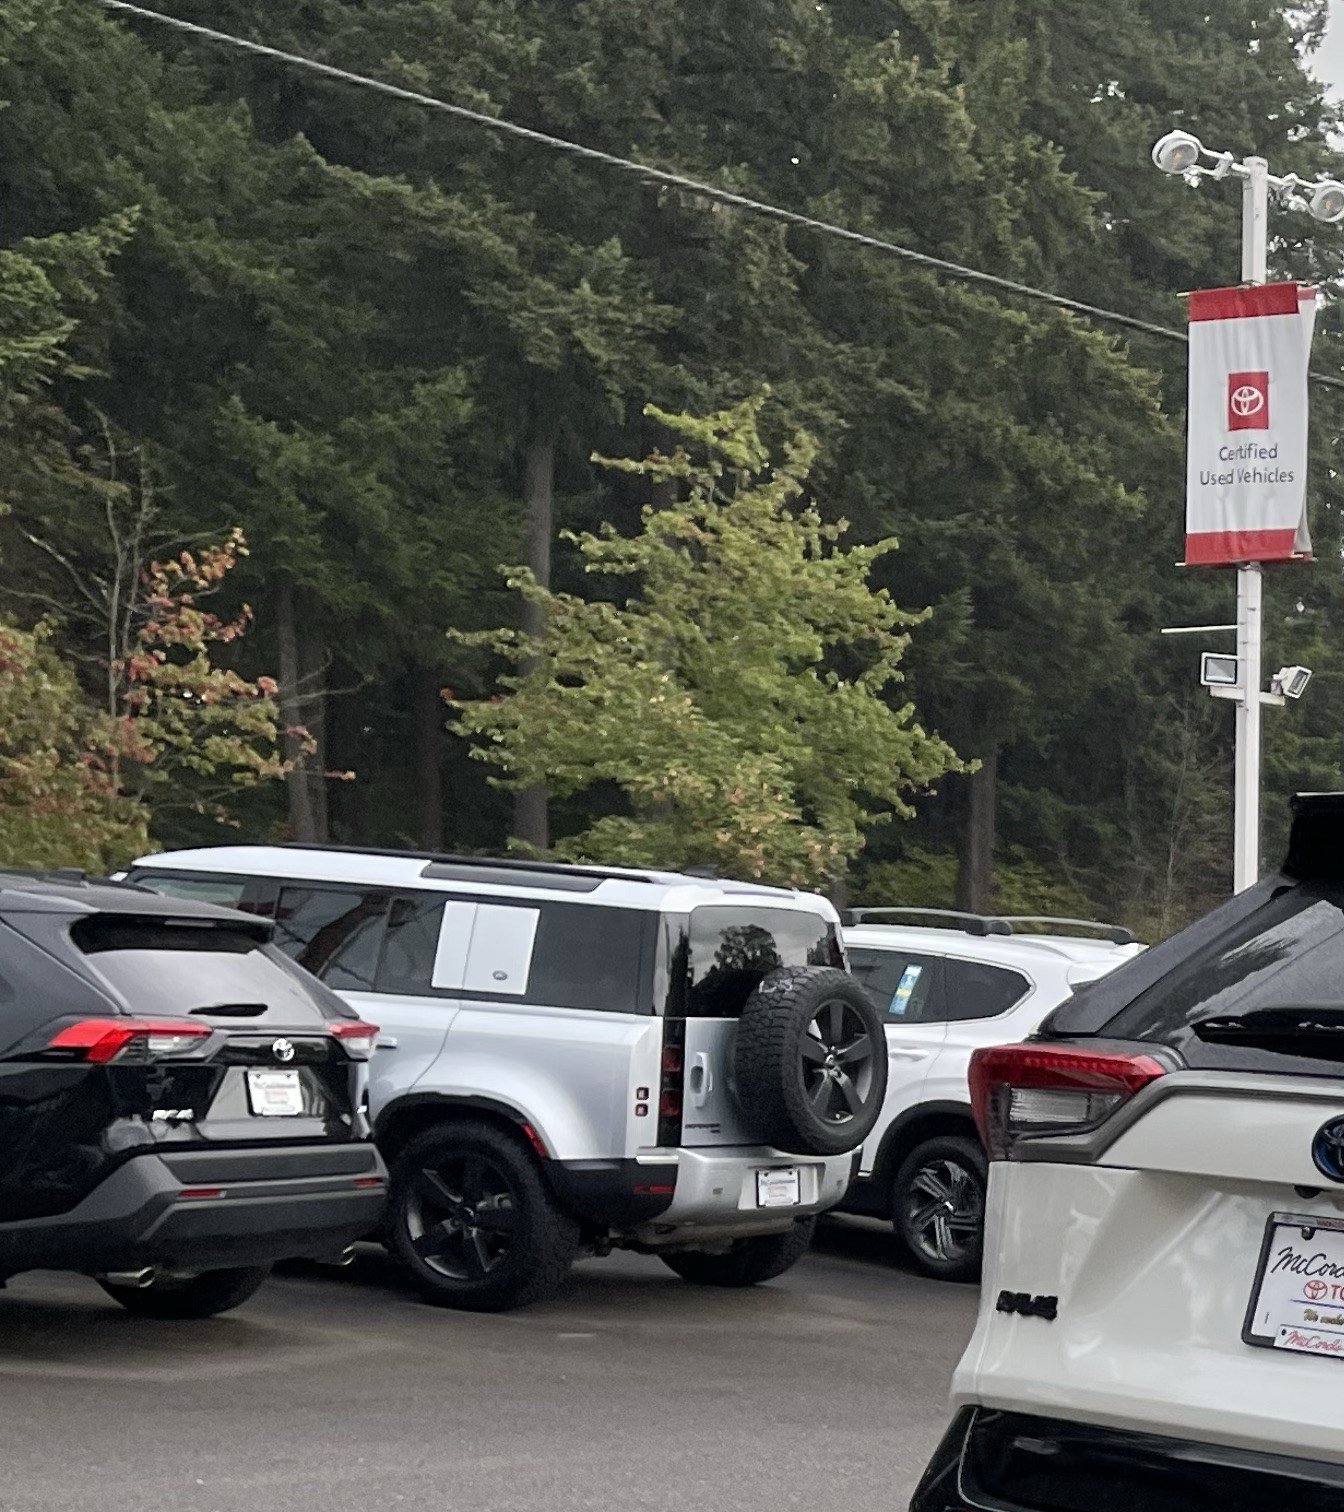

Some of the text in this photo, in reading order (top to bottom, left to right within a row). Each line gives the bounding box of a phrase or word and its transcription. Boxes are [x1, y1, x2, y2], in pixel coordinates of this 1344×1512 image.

[1219, 442, 1278, 461] Certified
[1200, 467, 1294, 485] Used Vehicles
